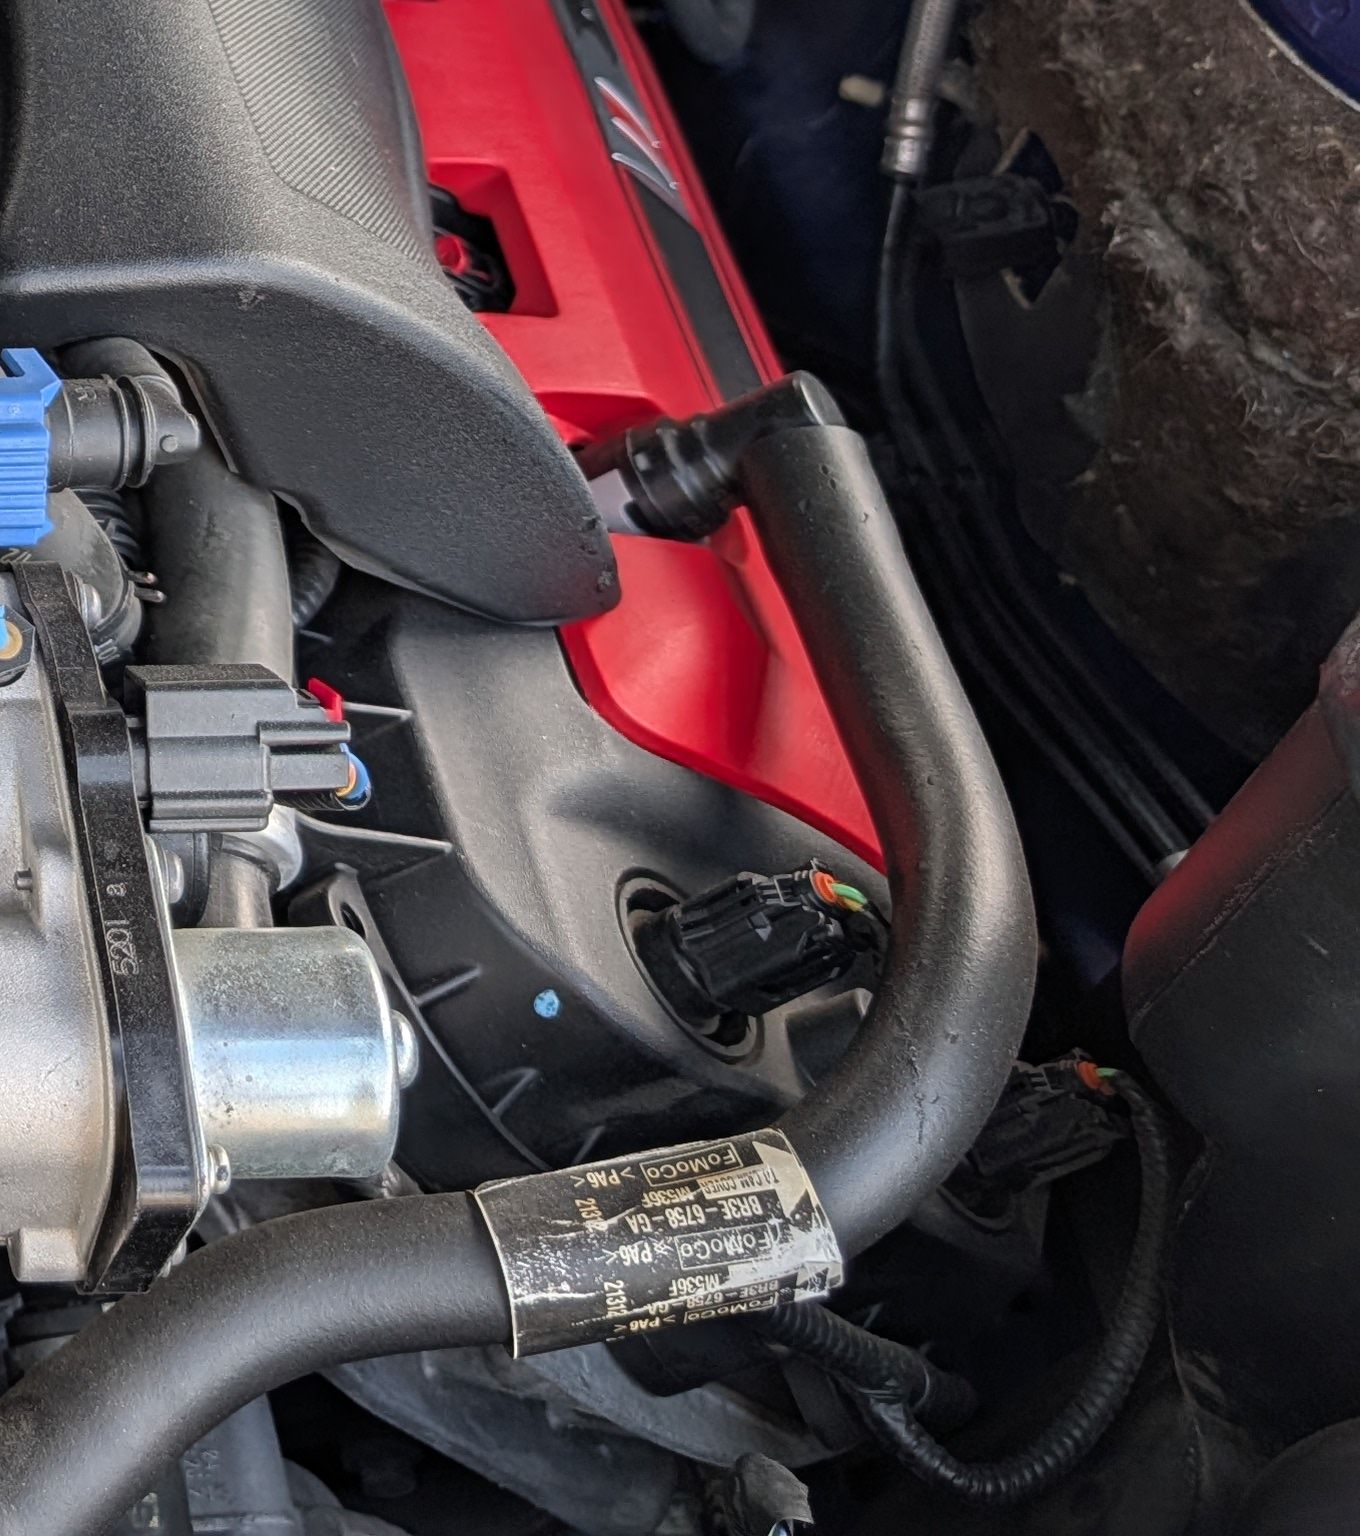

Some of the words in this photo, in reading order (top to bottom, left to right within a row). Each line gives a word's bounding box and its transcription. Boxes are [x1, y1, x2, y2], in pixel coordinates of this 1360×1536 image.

[647, 1147, 737, 1179] FoMoCo
[641, 1185, 695, 1208] M536F
[700, 1175, 737, 1195] COVER
[680, 1230, 772, 1261] FoMoCo
[668, 1274, 721, 1295] M536F
